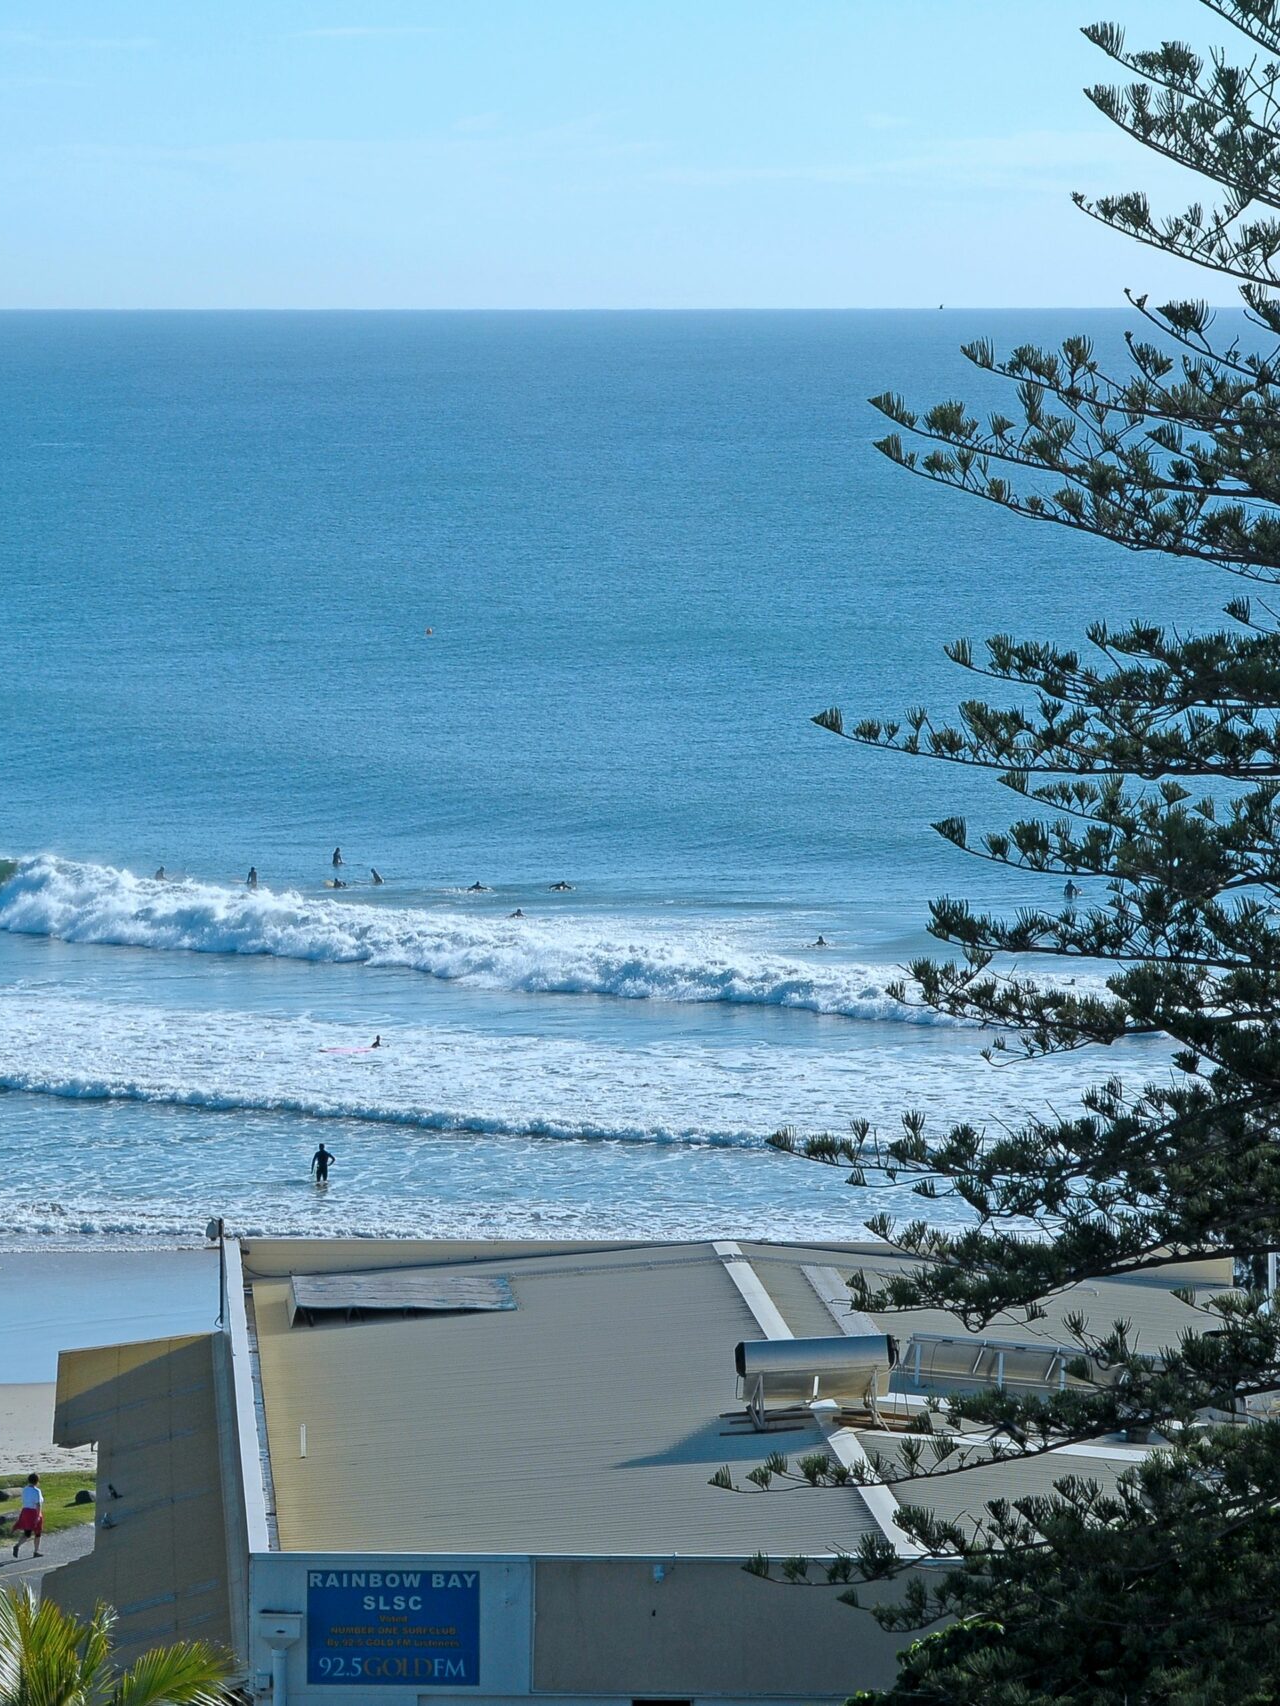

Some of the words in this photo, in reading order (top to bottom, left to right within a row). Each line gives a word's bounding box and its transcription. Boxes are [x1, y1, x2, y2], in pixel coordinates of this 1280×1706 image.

[309, 1573, 422, 1588] RAINBOW
[431, 1573, 477, 1588] BAY
[363, 1595, 423, 1610] SLSC
[330, 1626, 374, 1634] NUMBER
[377, 1626, 399, 1634] ONE
[366, 1638, 394, 1646] GOLD
[397, 1638, 411, 1646] FM
